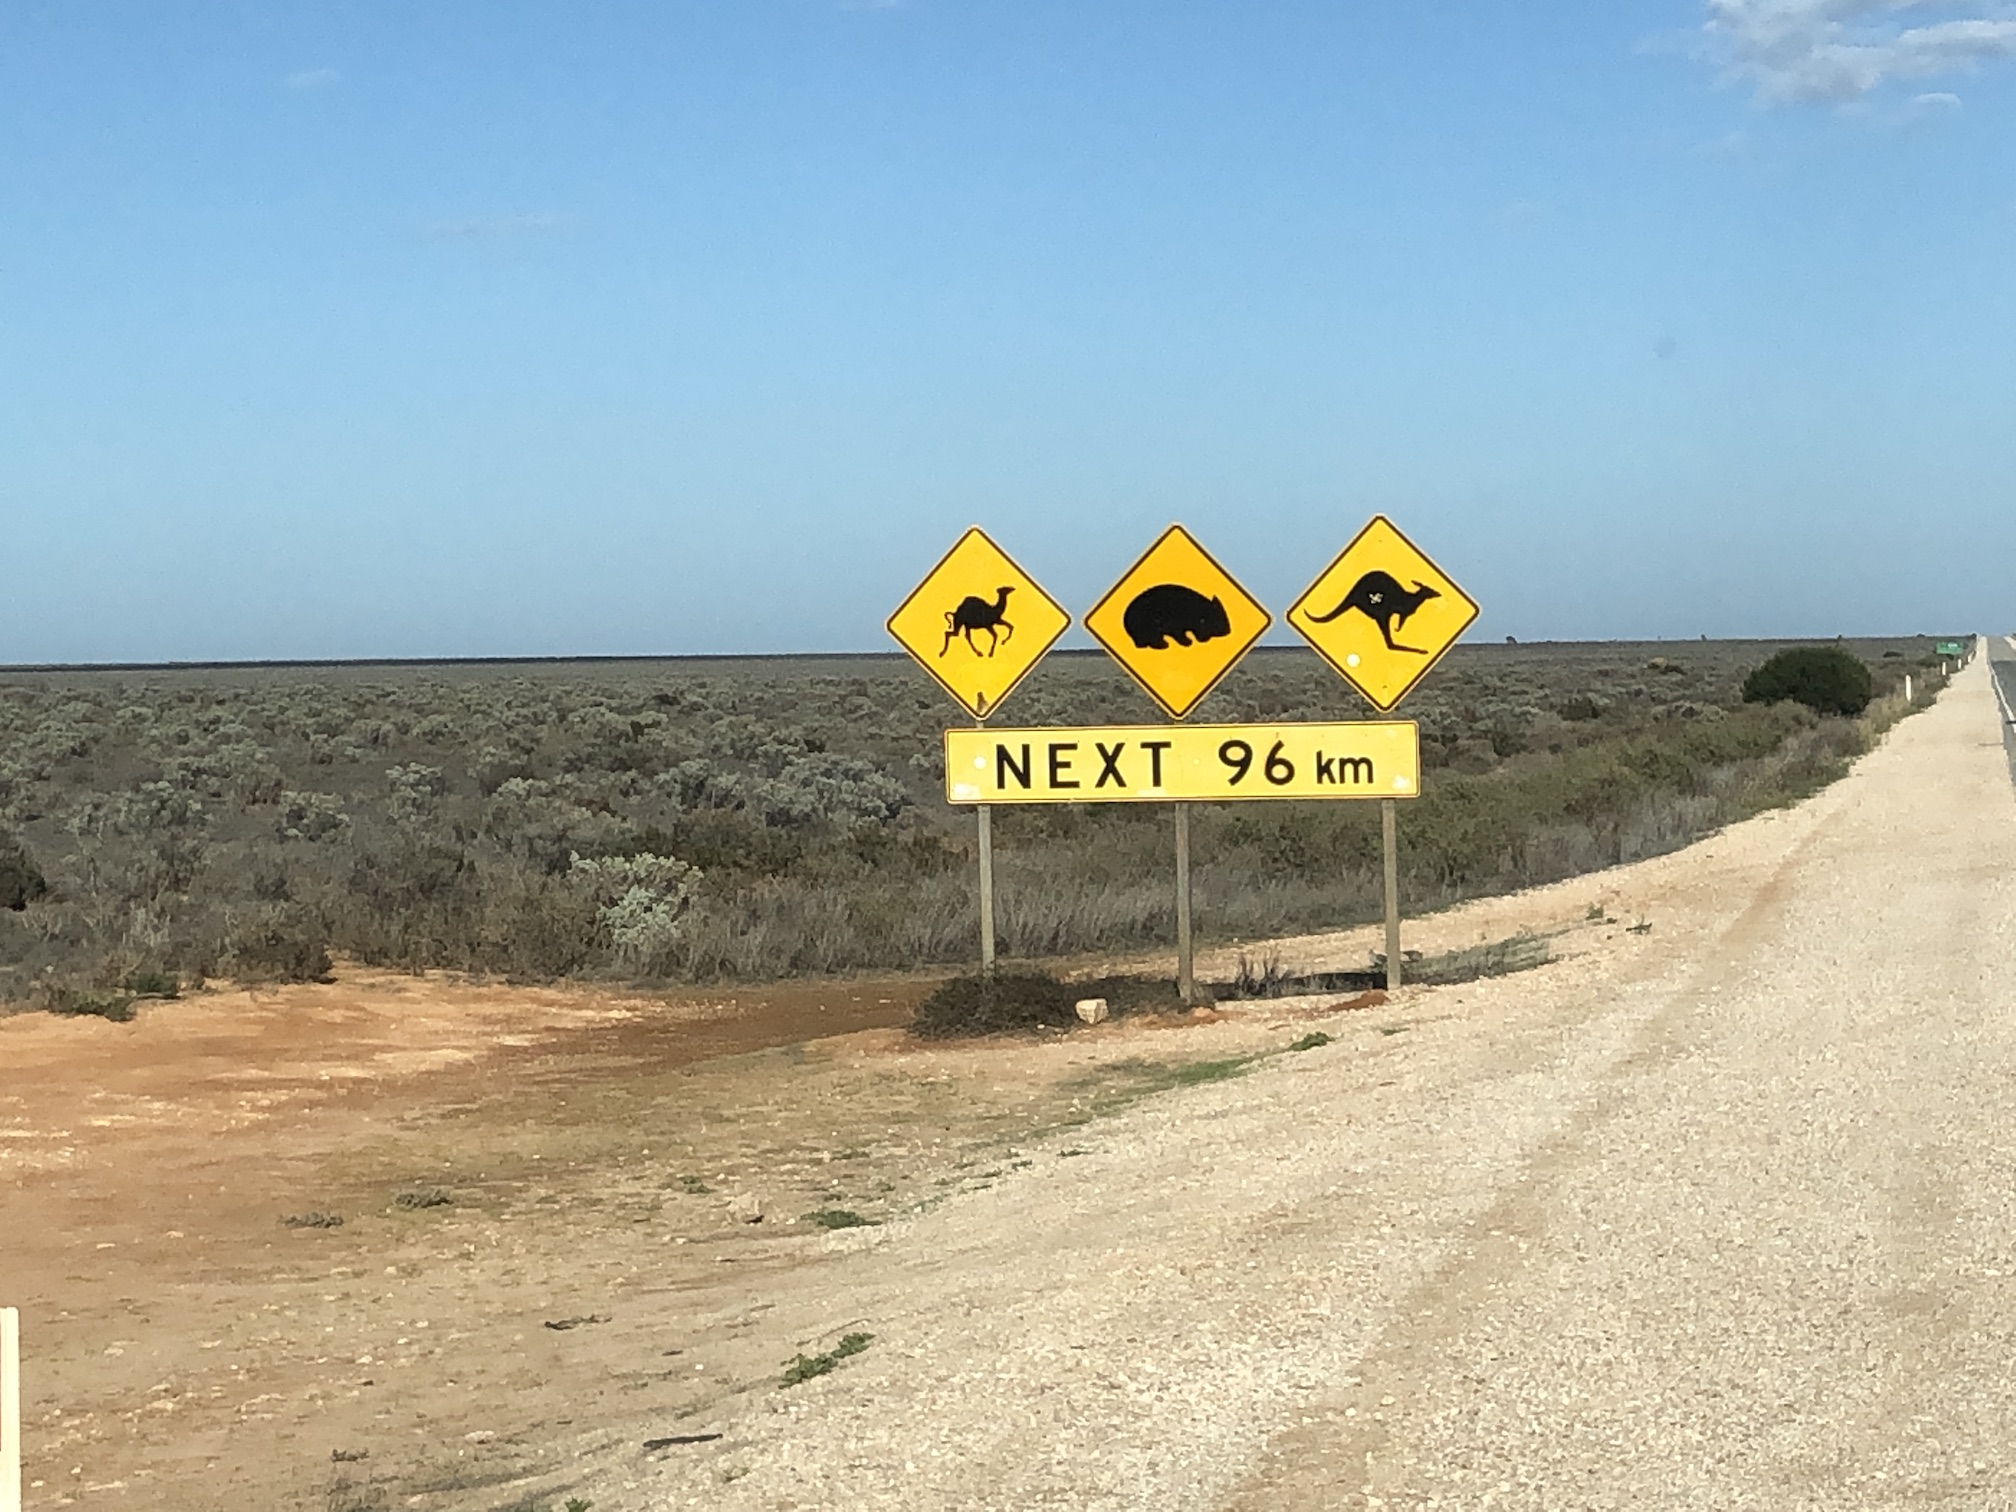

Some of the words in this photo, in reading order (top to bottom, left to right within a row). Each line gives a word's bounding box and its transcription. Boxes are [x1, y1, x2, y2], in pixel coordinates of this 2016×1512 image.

[996, 741, 1172, 790] NEXT
[1218, 739, 1295, 786] 96
[1316, 750, 1374, 785] km
